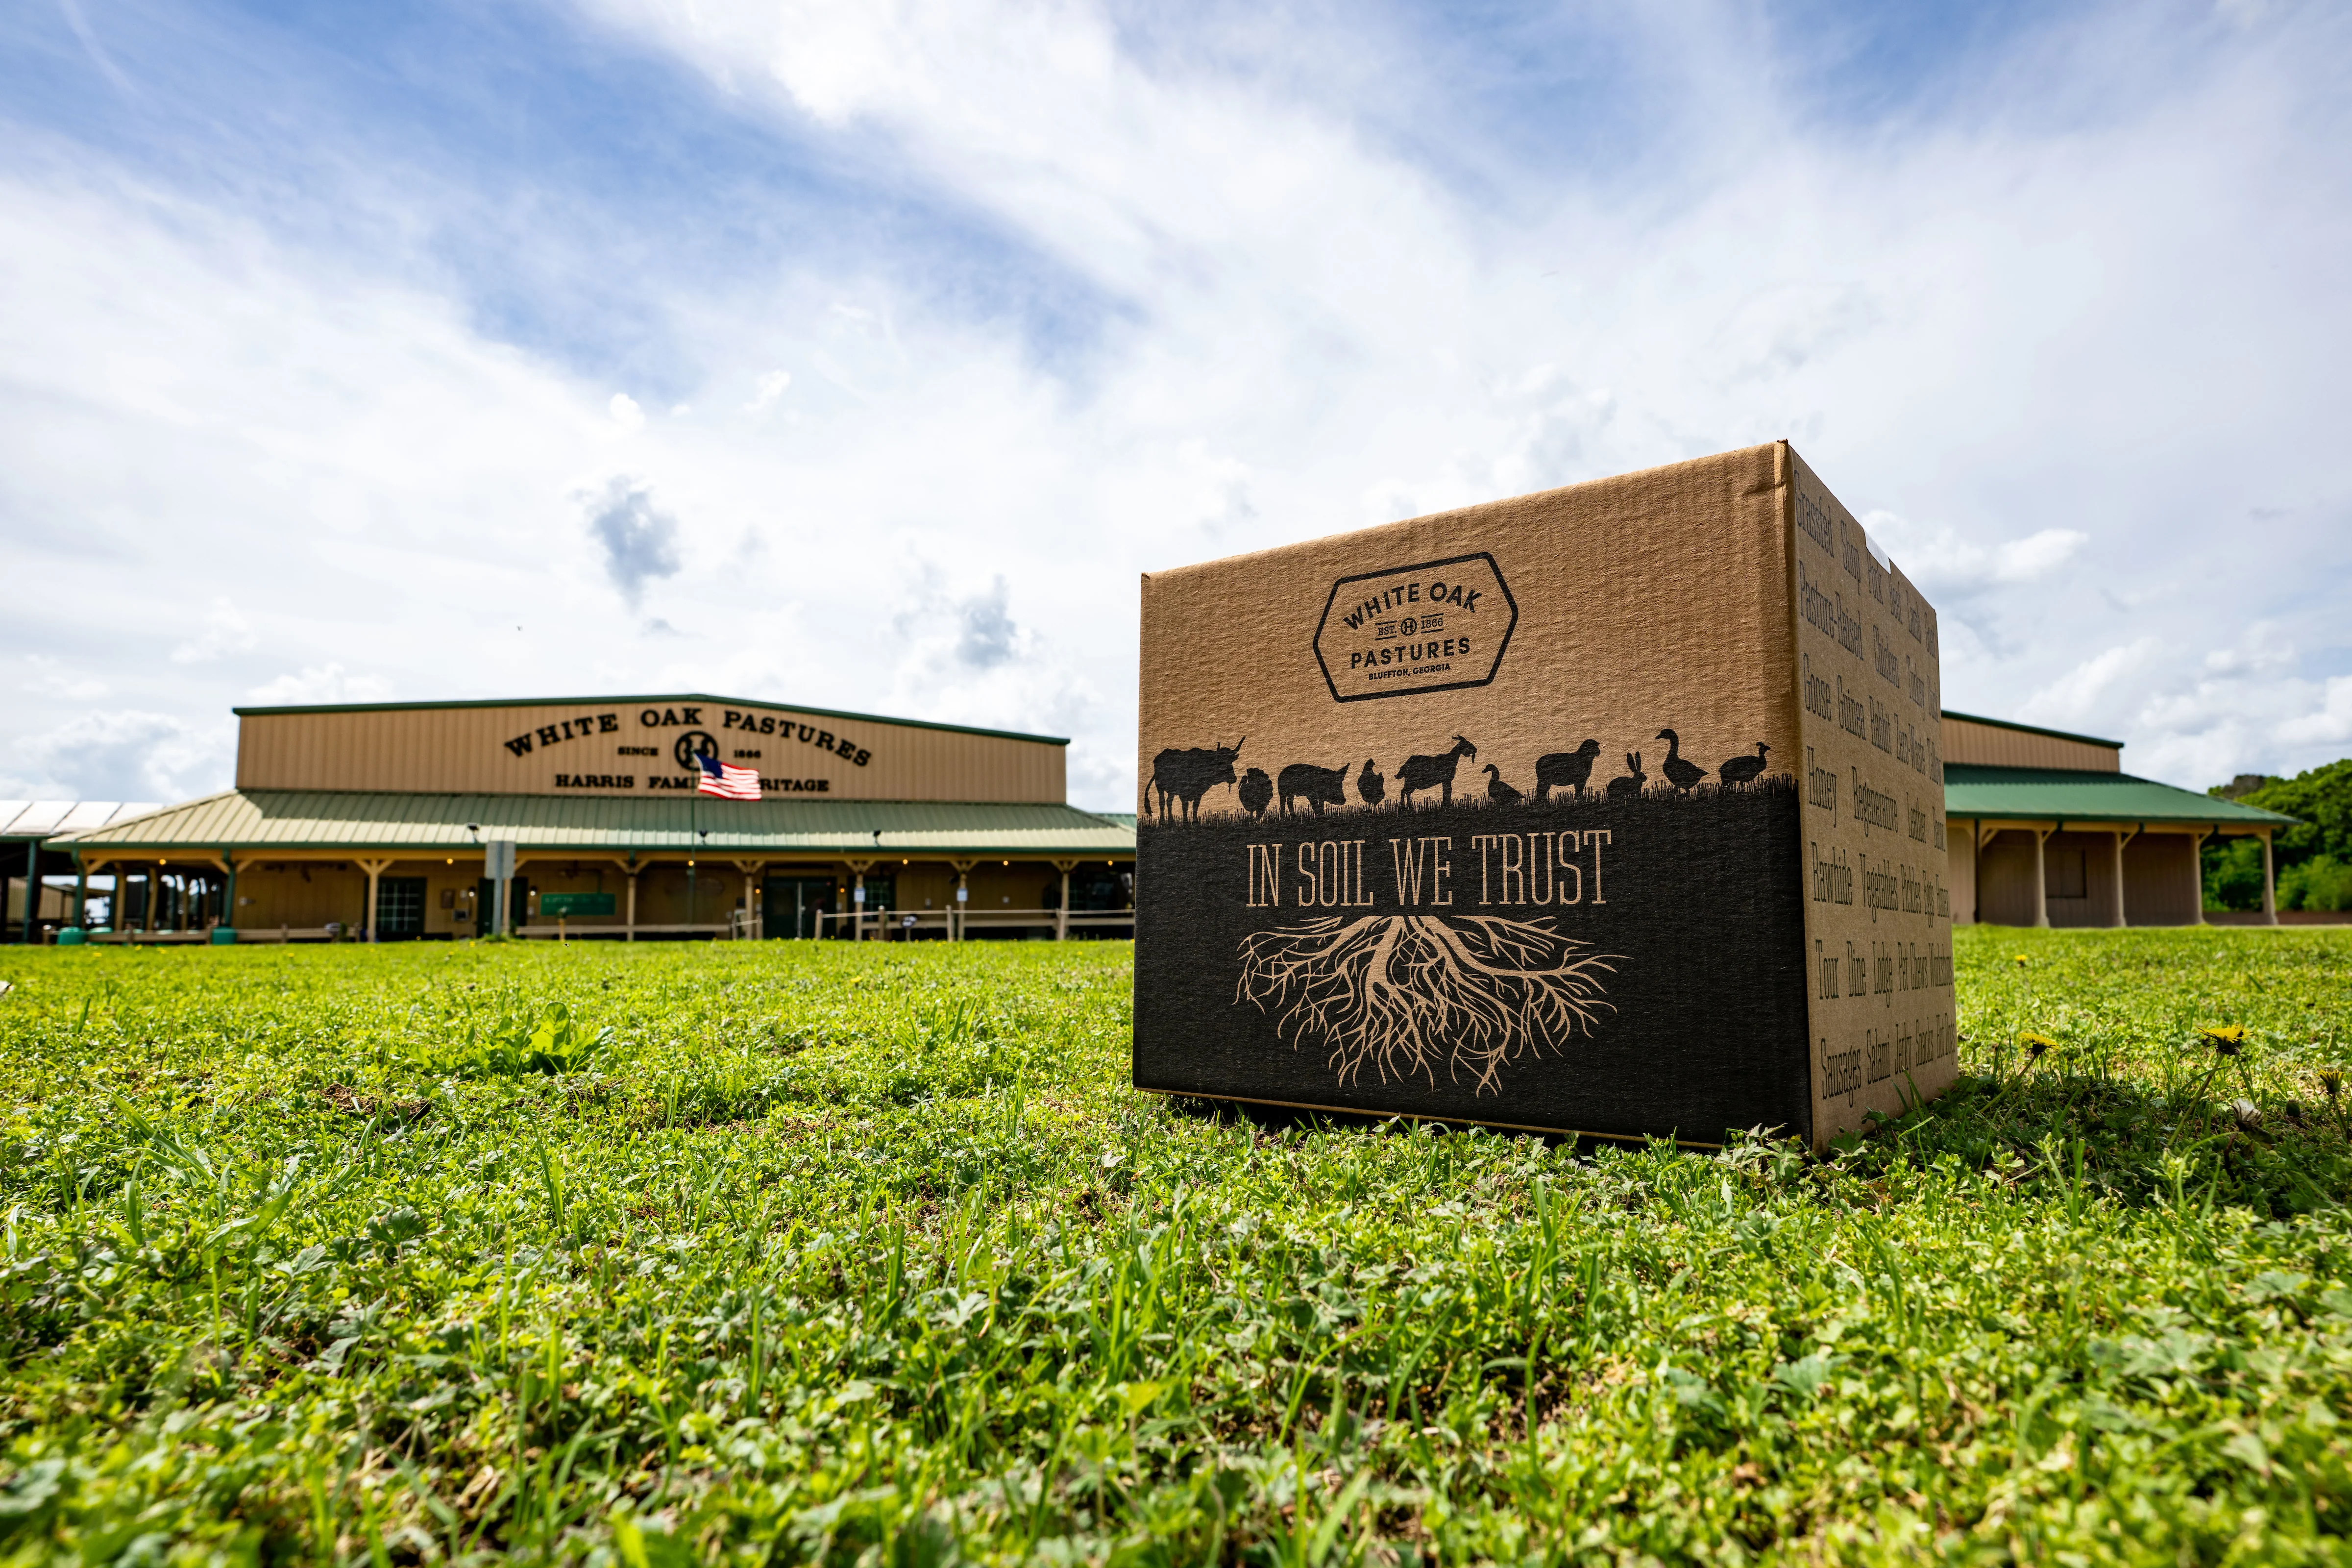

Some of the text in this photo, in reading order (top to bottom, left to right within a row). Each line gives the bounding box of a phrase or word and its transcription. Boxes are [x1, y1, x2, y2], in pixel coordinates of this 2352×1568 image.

[1794, 470, 1936, 659] Grassfed Shop Pork Beef Lamb Goat
[1343, 582, 1482, 630] WHITE OAK
[1377, 626, 1396, 636] EST.
[1421, 617, 1444, 629] 1866
[1351, 637, 1470, 669] PASTURES
[1369, 663, 1450, 681] BLUFFTON, GEORGIA
[1799, 560, 1938, 723] Pasture-Raised Chicken Turkey Duck
[504, 708, 872, 767] WHITE OAK PASTURES
[617, 746, 659, 757] SINCE
[1803, 652, 1941, 786] Goose Guinea Rabbit Zero-Waste Tallow
[555, 774, 829, 792] HARRIS FAM RITAGE
[1807, 746, 1837, 828] Honey
[1851, 765, 1898, 837] Regenerative
[1906, 792, 1926, 844] Leather
[1246, 830, 1612, 908] IN SOIL WE TRUST
[1811, 841, 1853, 906] Rawhide
[1859, 853, 1898, 924] Vegetables
[1900, 863, 1921, 914] Pickles
[1922, 870, 1934, 928] Eggs
[1815, 939, 1952, 1008] Tour Dine Lodge Pet Chews Workshops
[1821, 1012, 1956, 1108] Sausages Salami Jerky Snacks Hot Dogs
